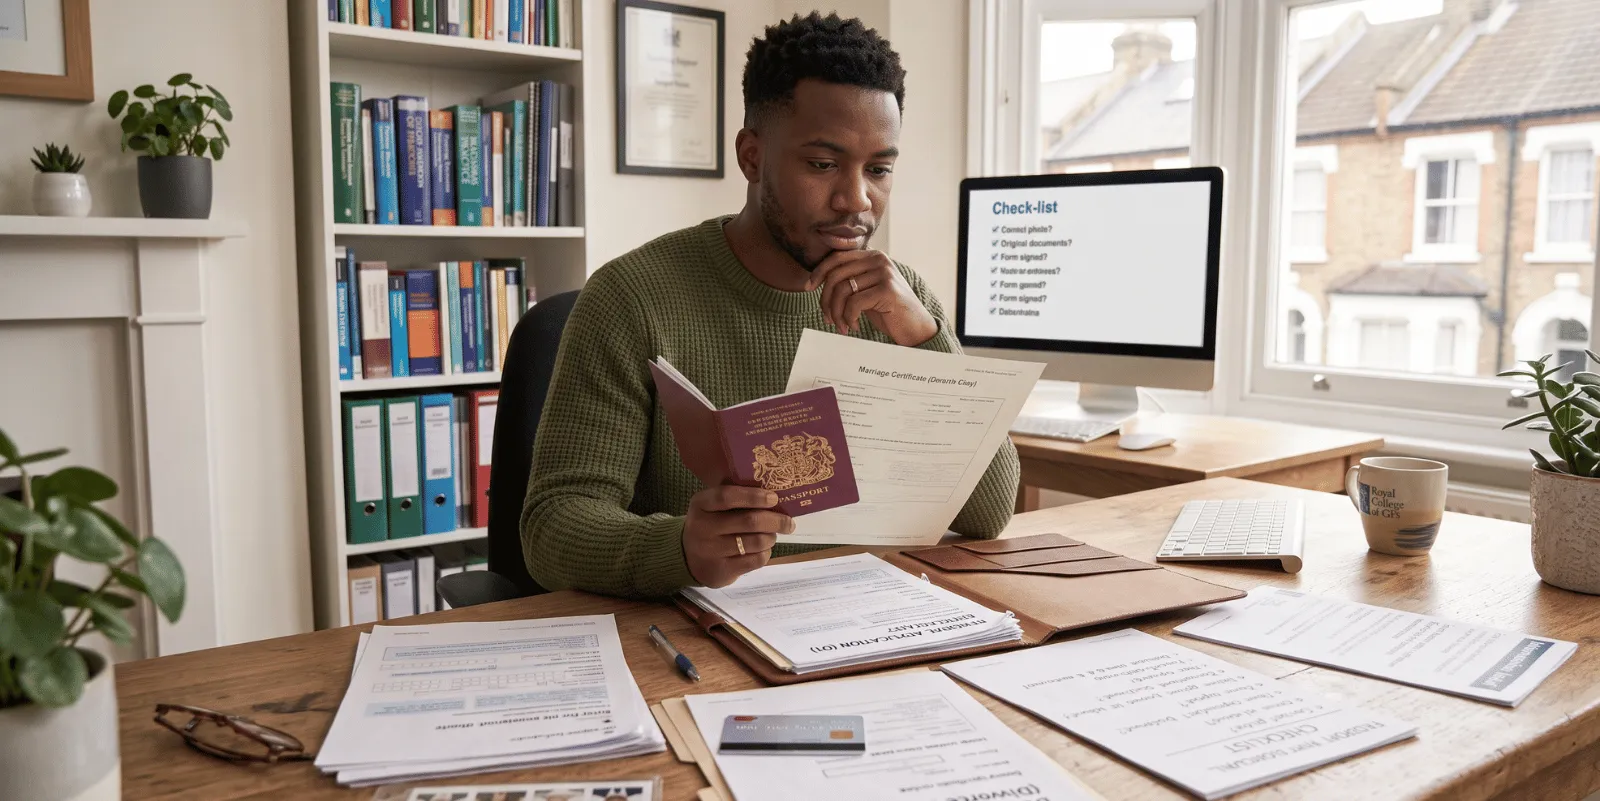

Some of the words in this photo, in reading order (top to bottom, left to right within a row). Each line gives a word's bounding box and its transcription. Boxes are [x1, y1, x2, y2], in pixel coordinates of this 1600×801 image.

[992, 201, 1059, 215] Check-list
[1029, 239, 1073, 247] documents?
[1000, 253, 1019, 261] Form
[1020, 253, 1048, 262] signed?
[999, 280, 1018, 288] Form
[999, 294, 1017, 302] Form
[1019, 295, 1047, 303] signed?
[858, 365, 890, 378] Marriage
[891, 371, 927, 382] Certificate
[778, 486, 830, 503] PASSPORT
[1371, 486, 1395, 498] Royal
[1371, 497, 1404, 510] College
[1371, 508, 1380, 516] of
[1223, 723, 1318, 754] CHECKLIST
